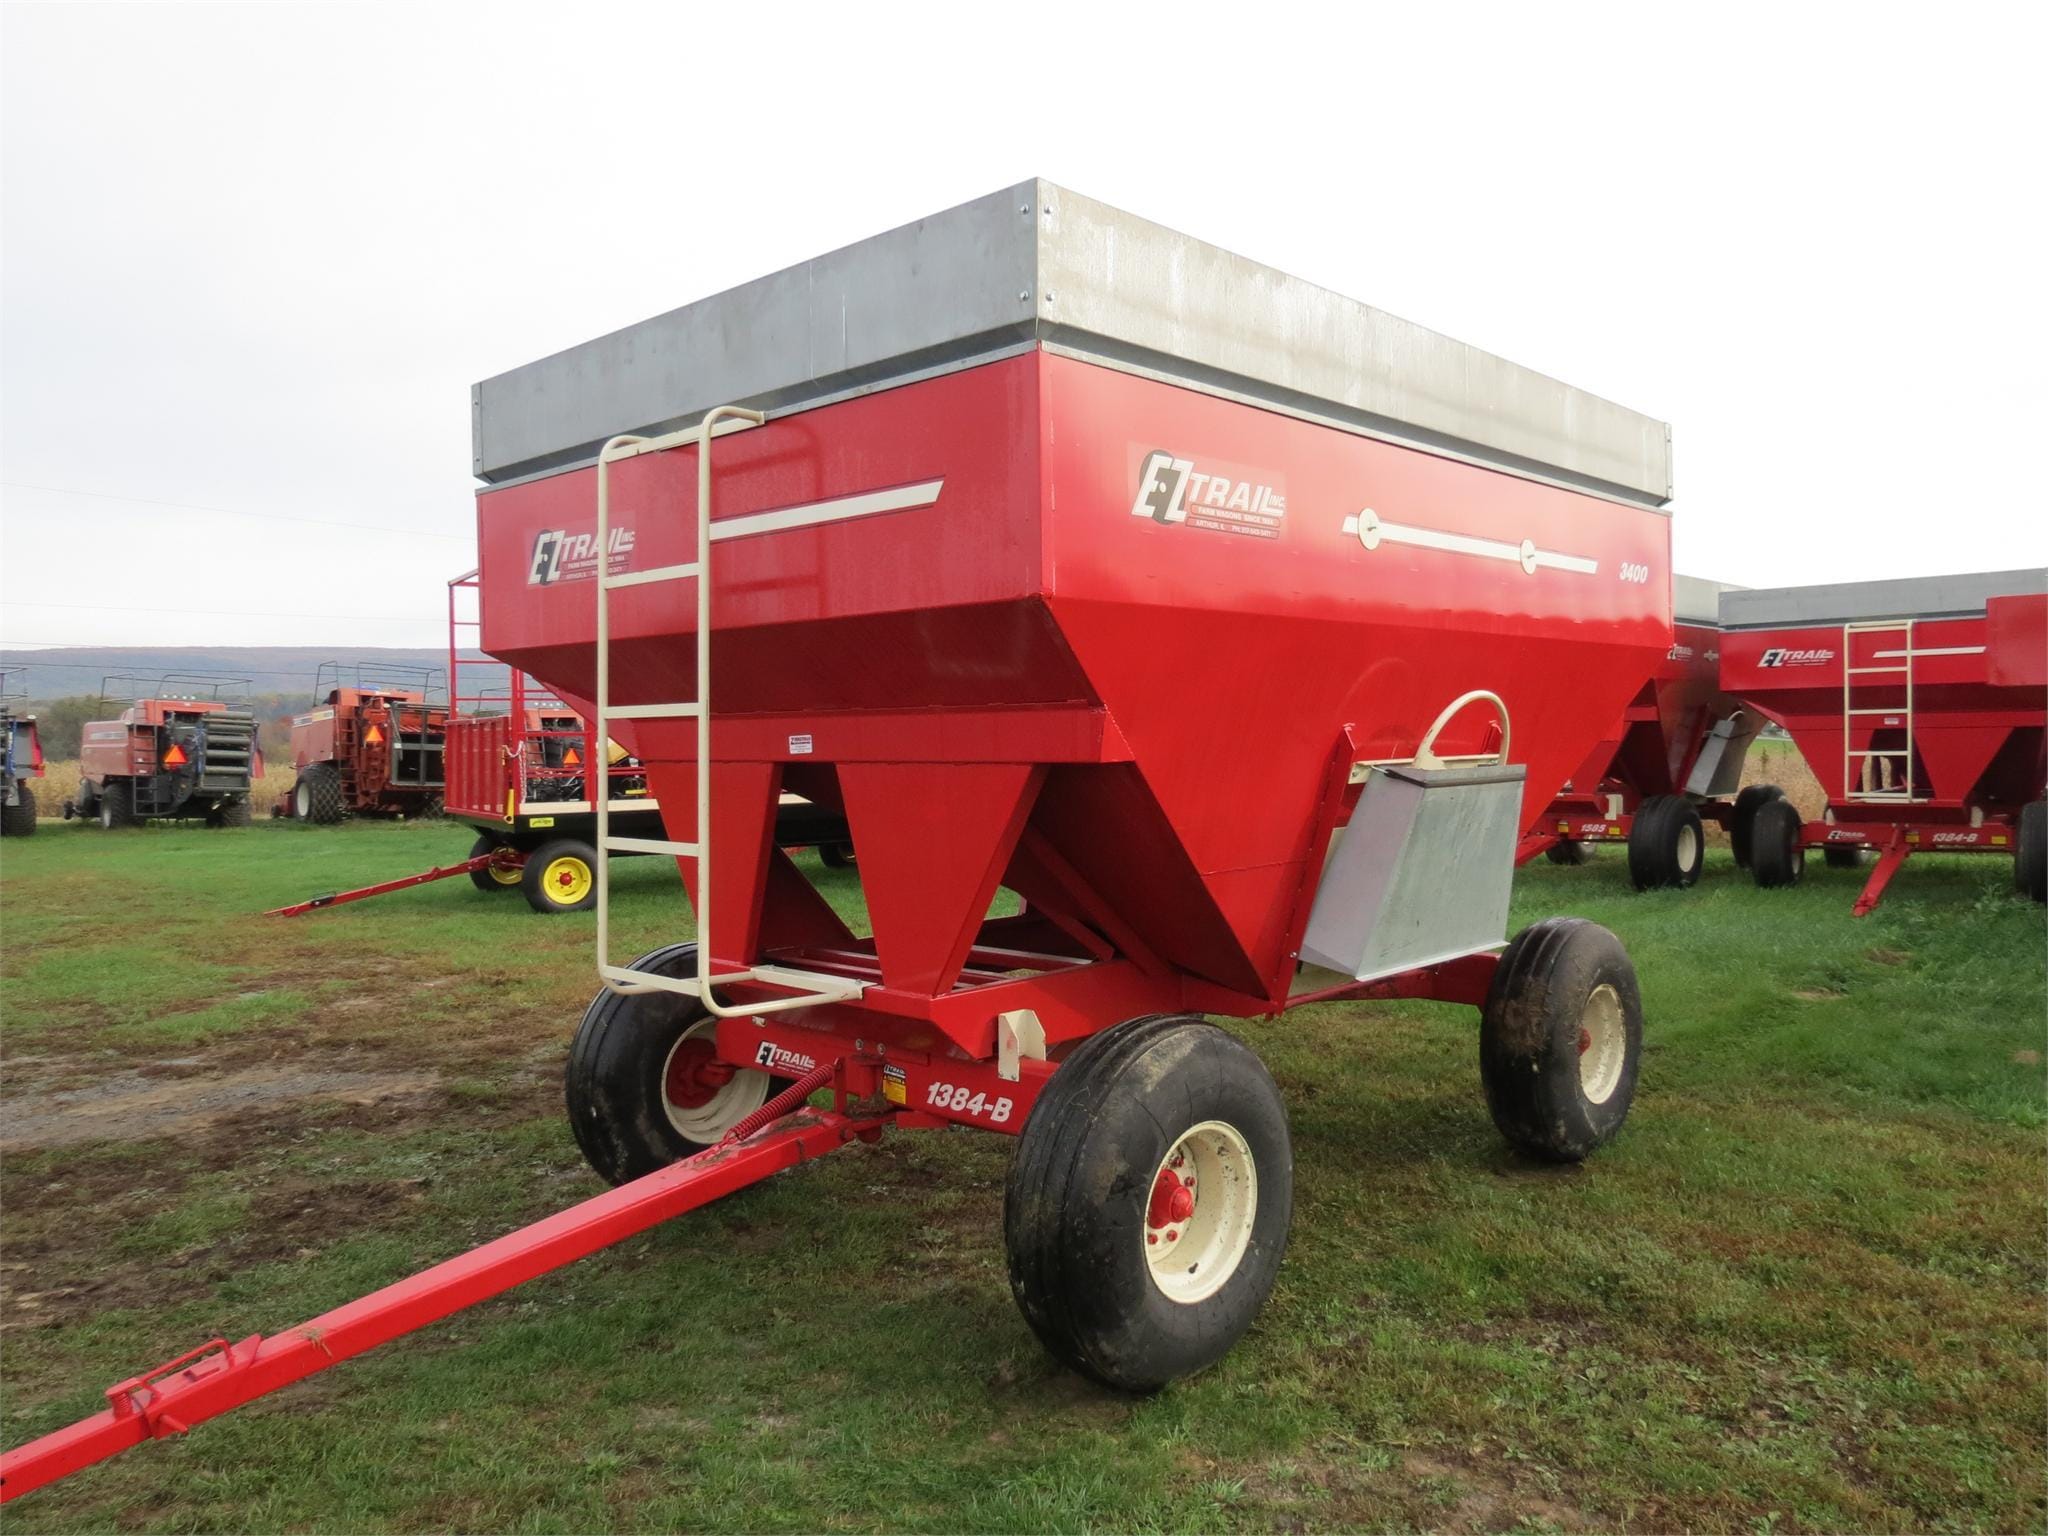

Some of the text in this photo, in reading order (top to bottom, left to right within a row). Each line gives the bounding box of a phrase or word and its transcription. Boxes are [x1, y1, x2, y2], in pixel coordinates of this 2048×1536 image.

[1188, 472, 1284, 517] TRAIL
[561, 527, 634, 562] TRAIL
[1620, 562, 1649, 584] 3400
[1932, 832, 1979, 843] 1384-B
[775, 1048, 815, 1069] TRAIL
[926, 1081, 1014, 1123] 1384-B
